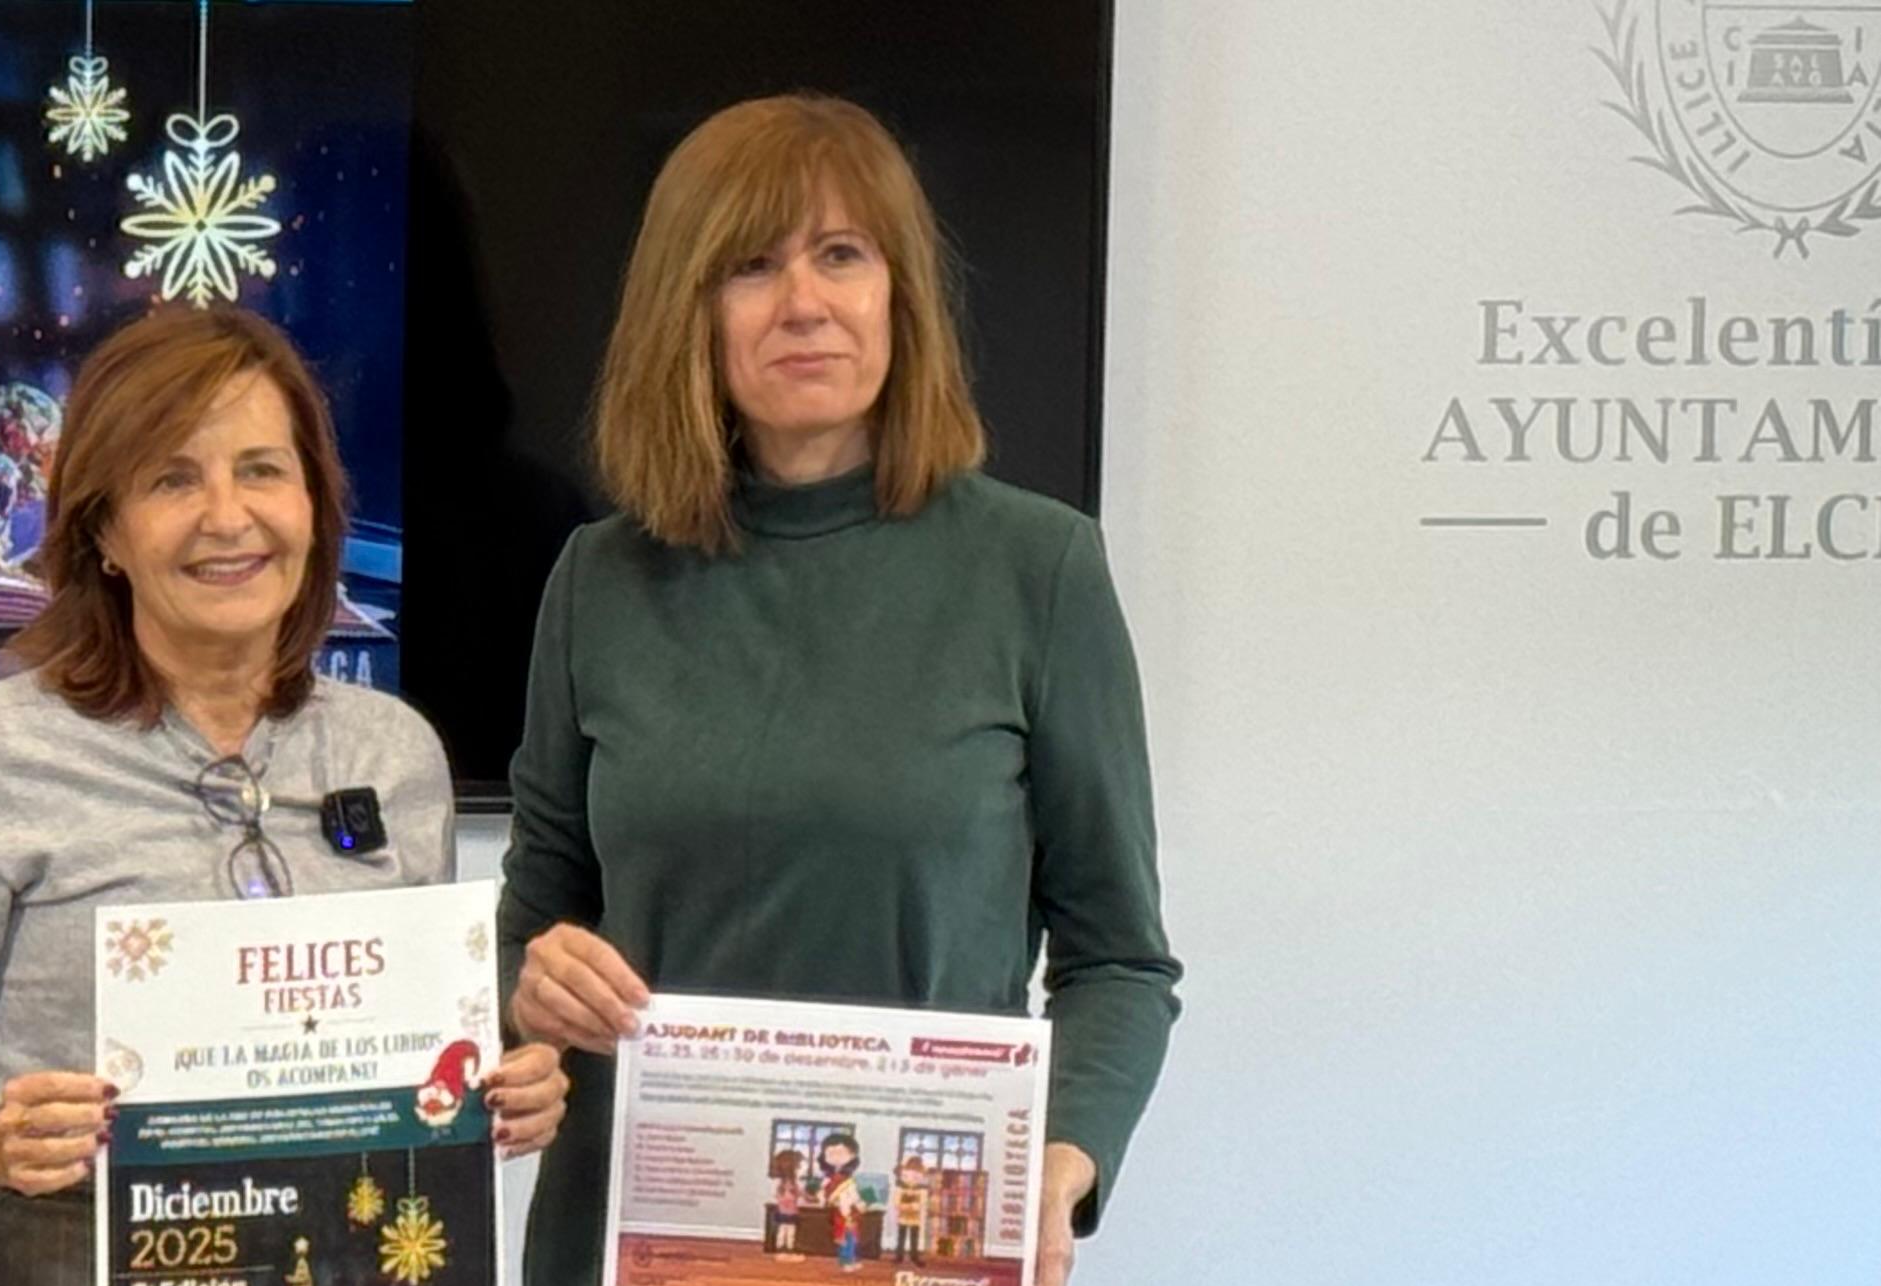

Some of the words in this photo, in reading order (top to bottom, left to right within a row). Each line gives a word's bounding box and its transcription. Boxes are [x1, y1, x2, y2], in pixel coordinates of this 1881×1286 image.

[1421, 397, 1879, 463] AYUNTAM
[1585, 491, 1681, 560] de
[237, 937, 386, 985] FELICES
[263, 982, 363, 1014] FIESTAS
[223, 1044, 248, 1066] LA
[254, 1041, 314, 1064] MAGIA
[319, 1039, 341, 1060] DE
[346, 1035, 379, 1057] LOS
[646, 1023, 737, 1042] AJUDANT
[743, 1029, 770, 1043] DE
[775, 1031, 891, 1052] BIBLIOTECA
[758, 1049, 780, 1064] de
[246, 1068, 271, 1088] OS
[129, 1176, 299, 1222] Diciembre
[130, 1224, 238, 1268] 2025
